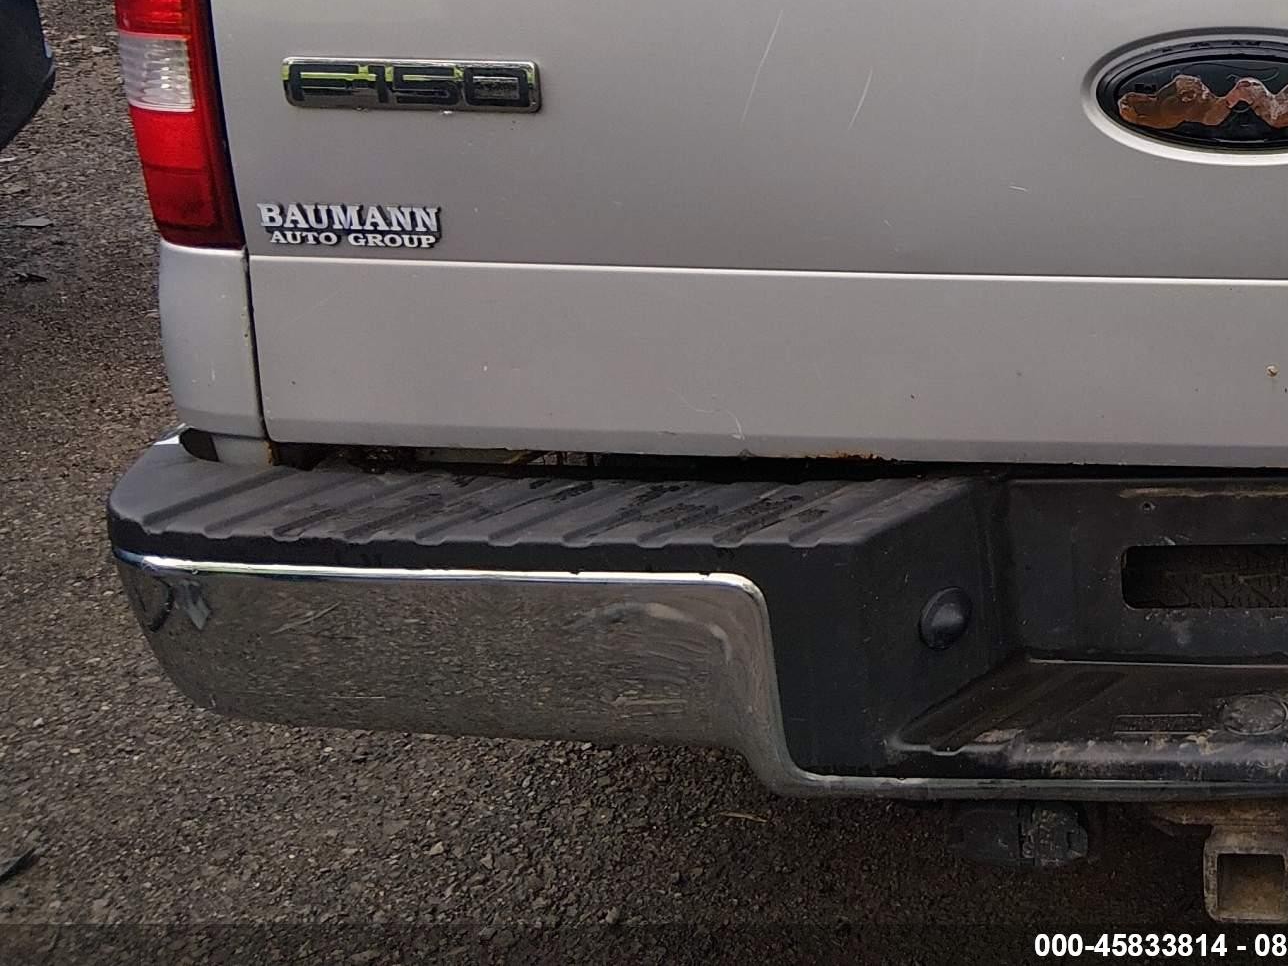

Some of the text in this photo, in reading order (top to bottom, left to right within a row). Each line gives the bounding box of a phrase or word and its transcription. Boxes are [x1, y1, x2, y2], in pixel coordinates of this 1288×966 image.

[257, 202, 438, 232] BAUMANN
[270, 230, 437, 248] AUTO GROUP
